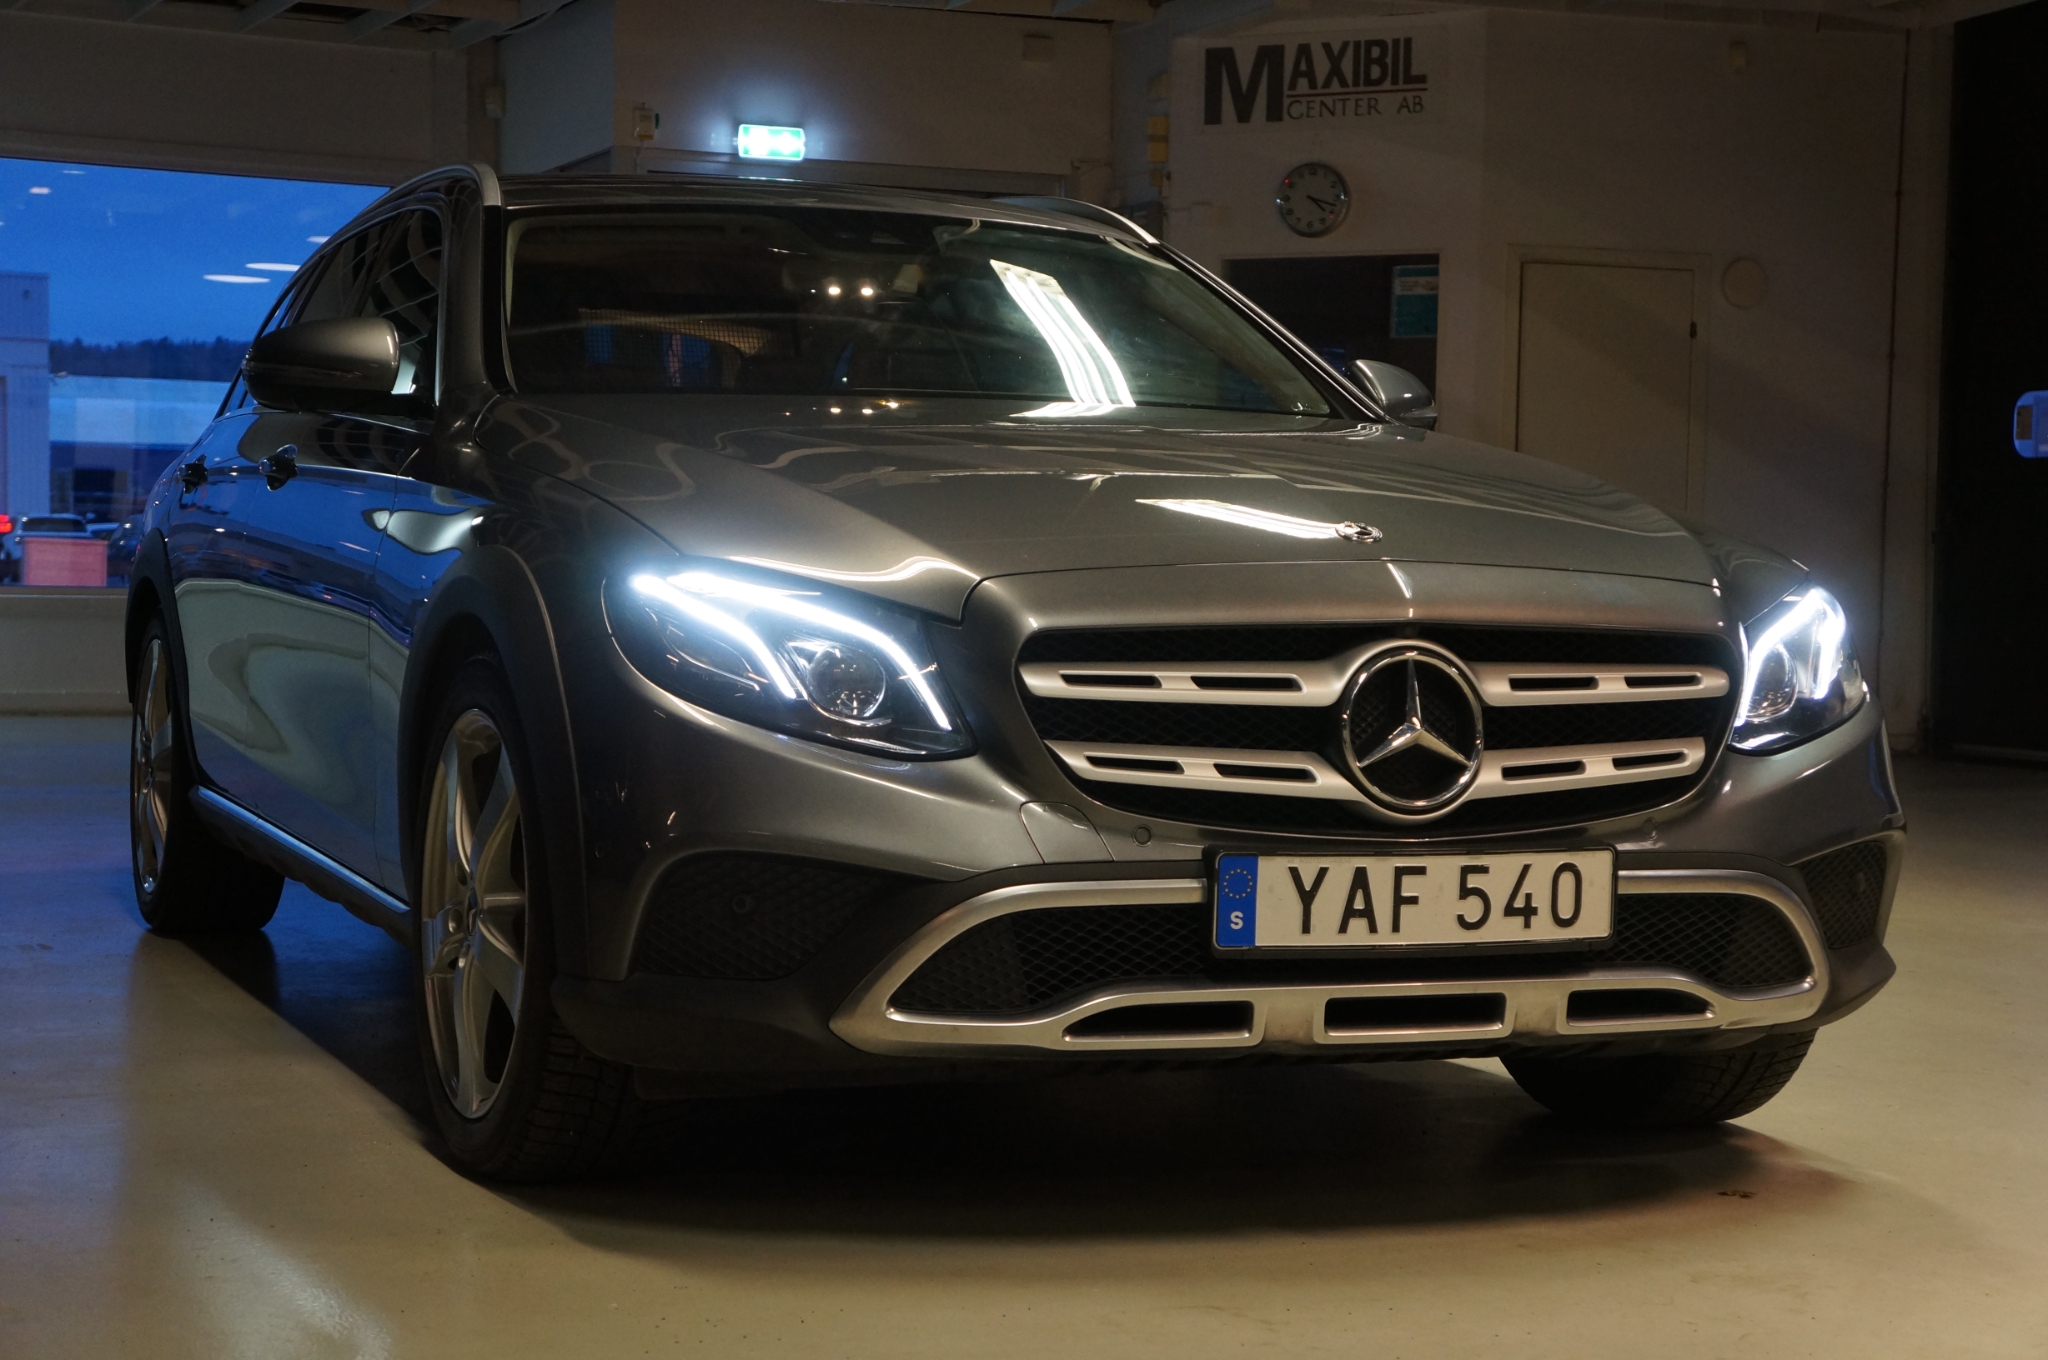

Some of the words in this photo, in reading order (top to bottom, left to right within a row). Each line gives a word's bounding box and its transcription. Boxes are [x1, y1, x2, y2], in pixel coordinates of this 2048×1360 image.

[1204, 37, 1428, 125] MAXIBIL
[1287, 97, 1382, 120] CENTER
[1396, 95, 1425, 114] AB
[1230, 911, 1244, 930] S
[1287, 864, 1428, 935] YAF
[1456, 861, 1583, 931] 540
